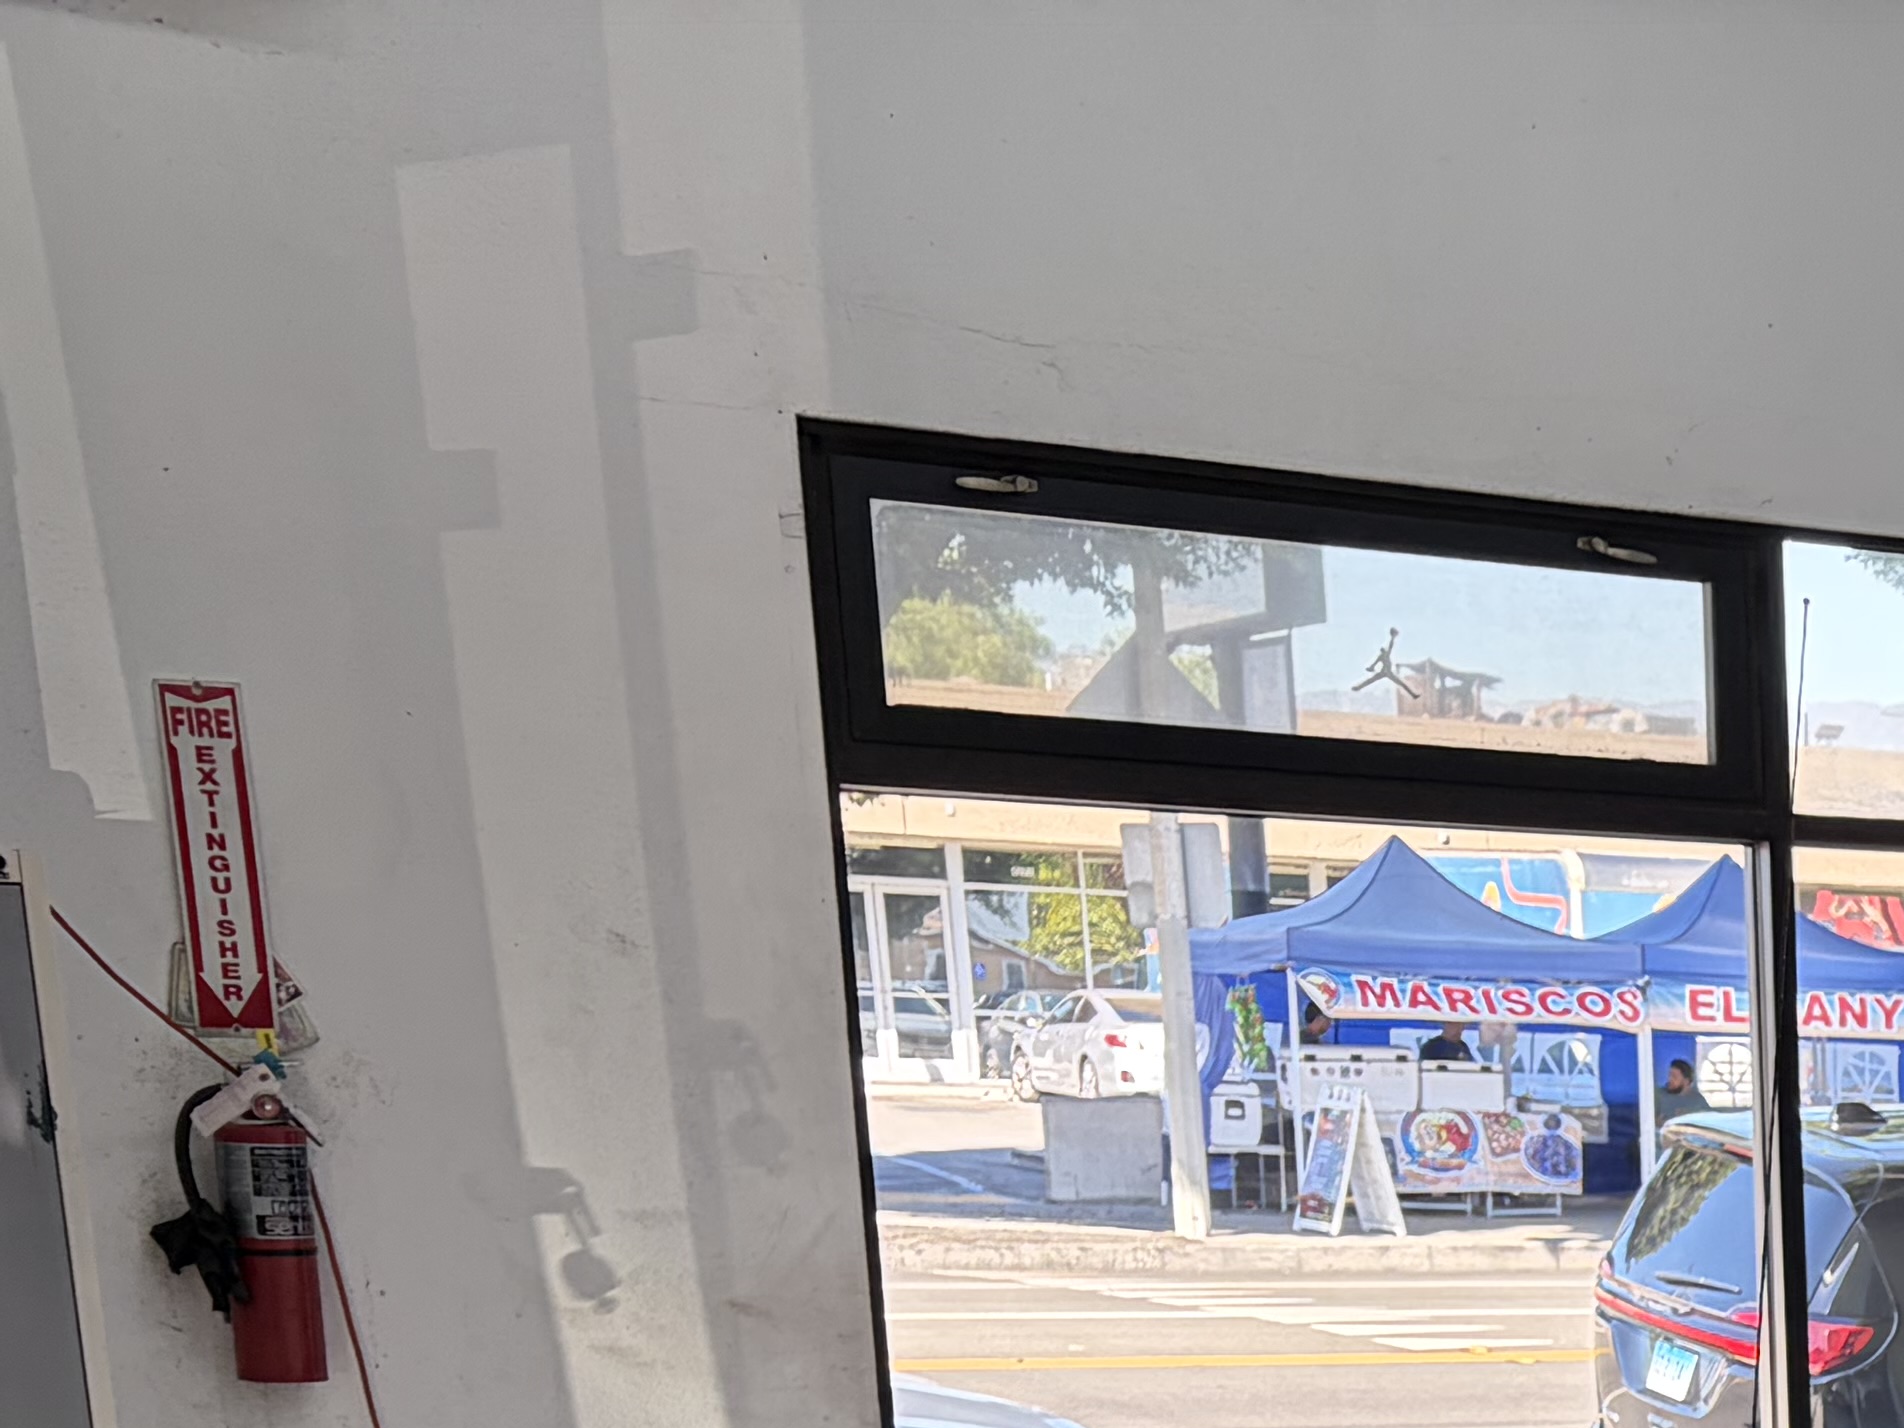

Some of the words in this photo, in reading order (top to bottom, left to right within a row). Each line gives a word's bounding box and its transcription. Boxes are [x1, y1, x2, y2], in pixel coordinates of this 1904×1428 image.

[169, 706, 233, 739] FIRE
[195, 745, 244, 1002] EXTINGUISHER
[1353, 978, 1643, 1025] MARISCOS
